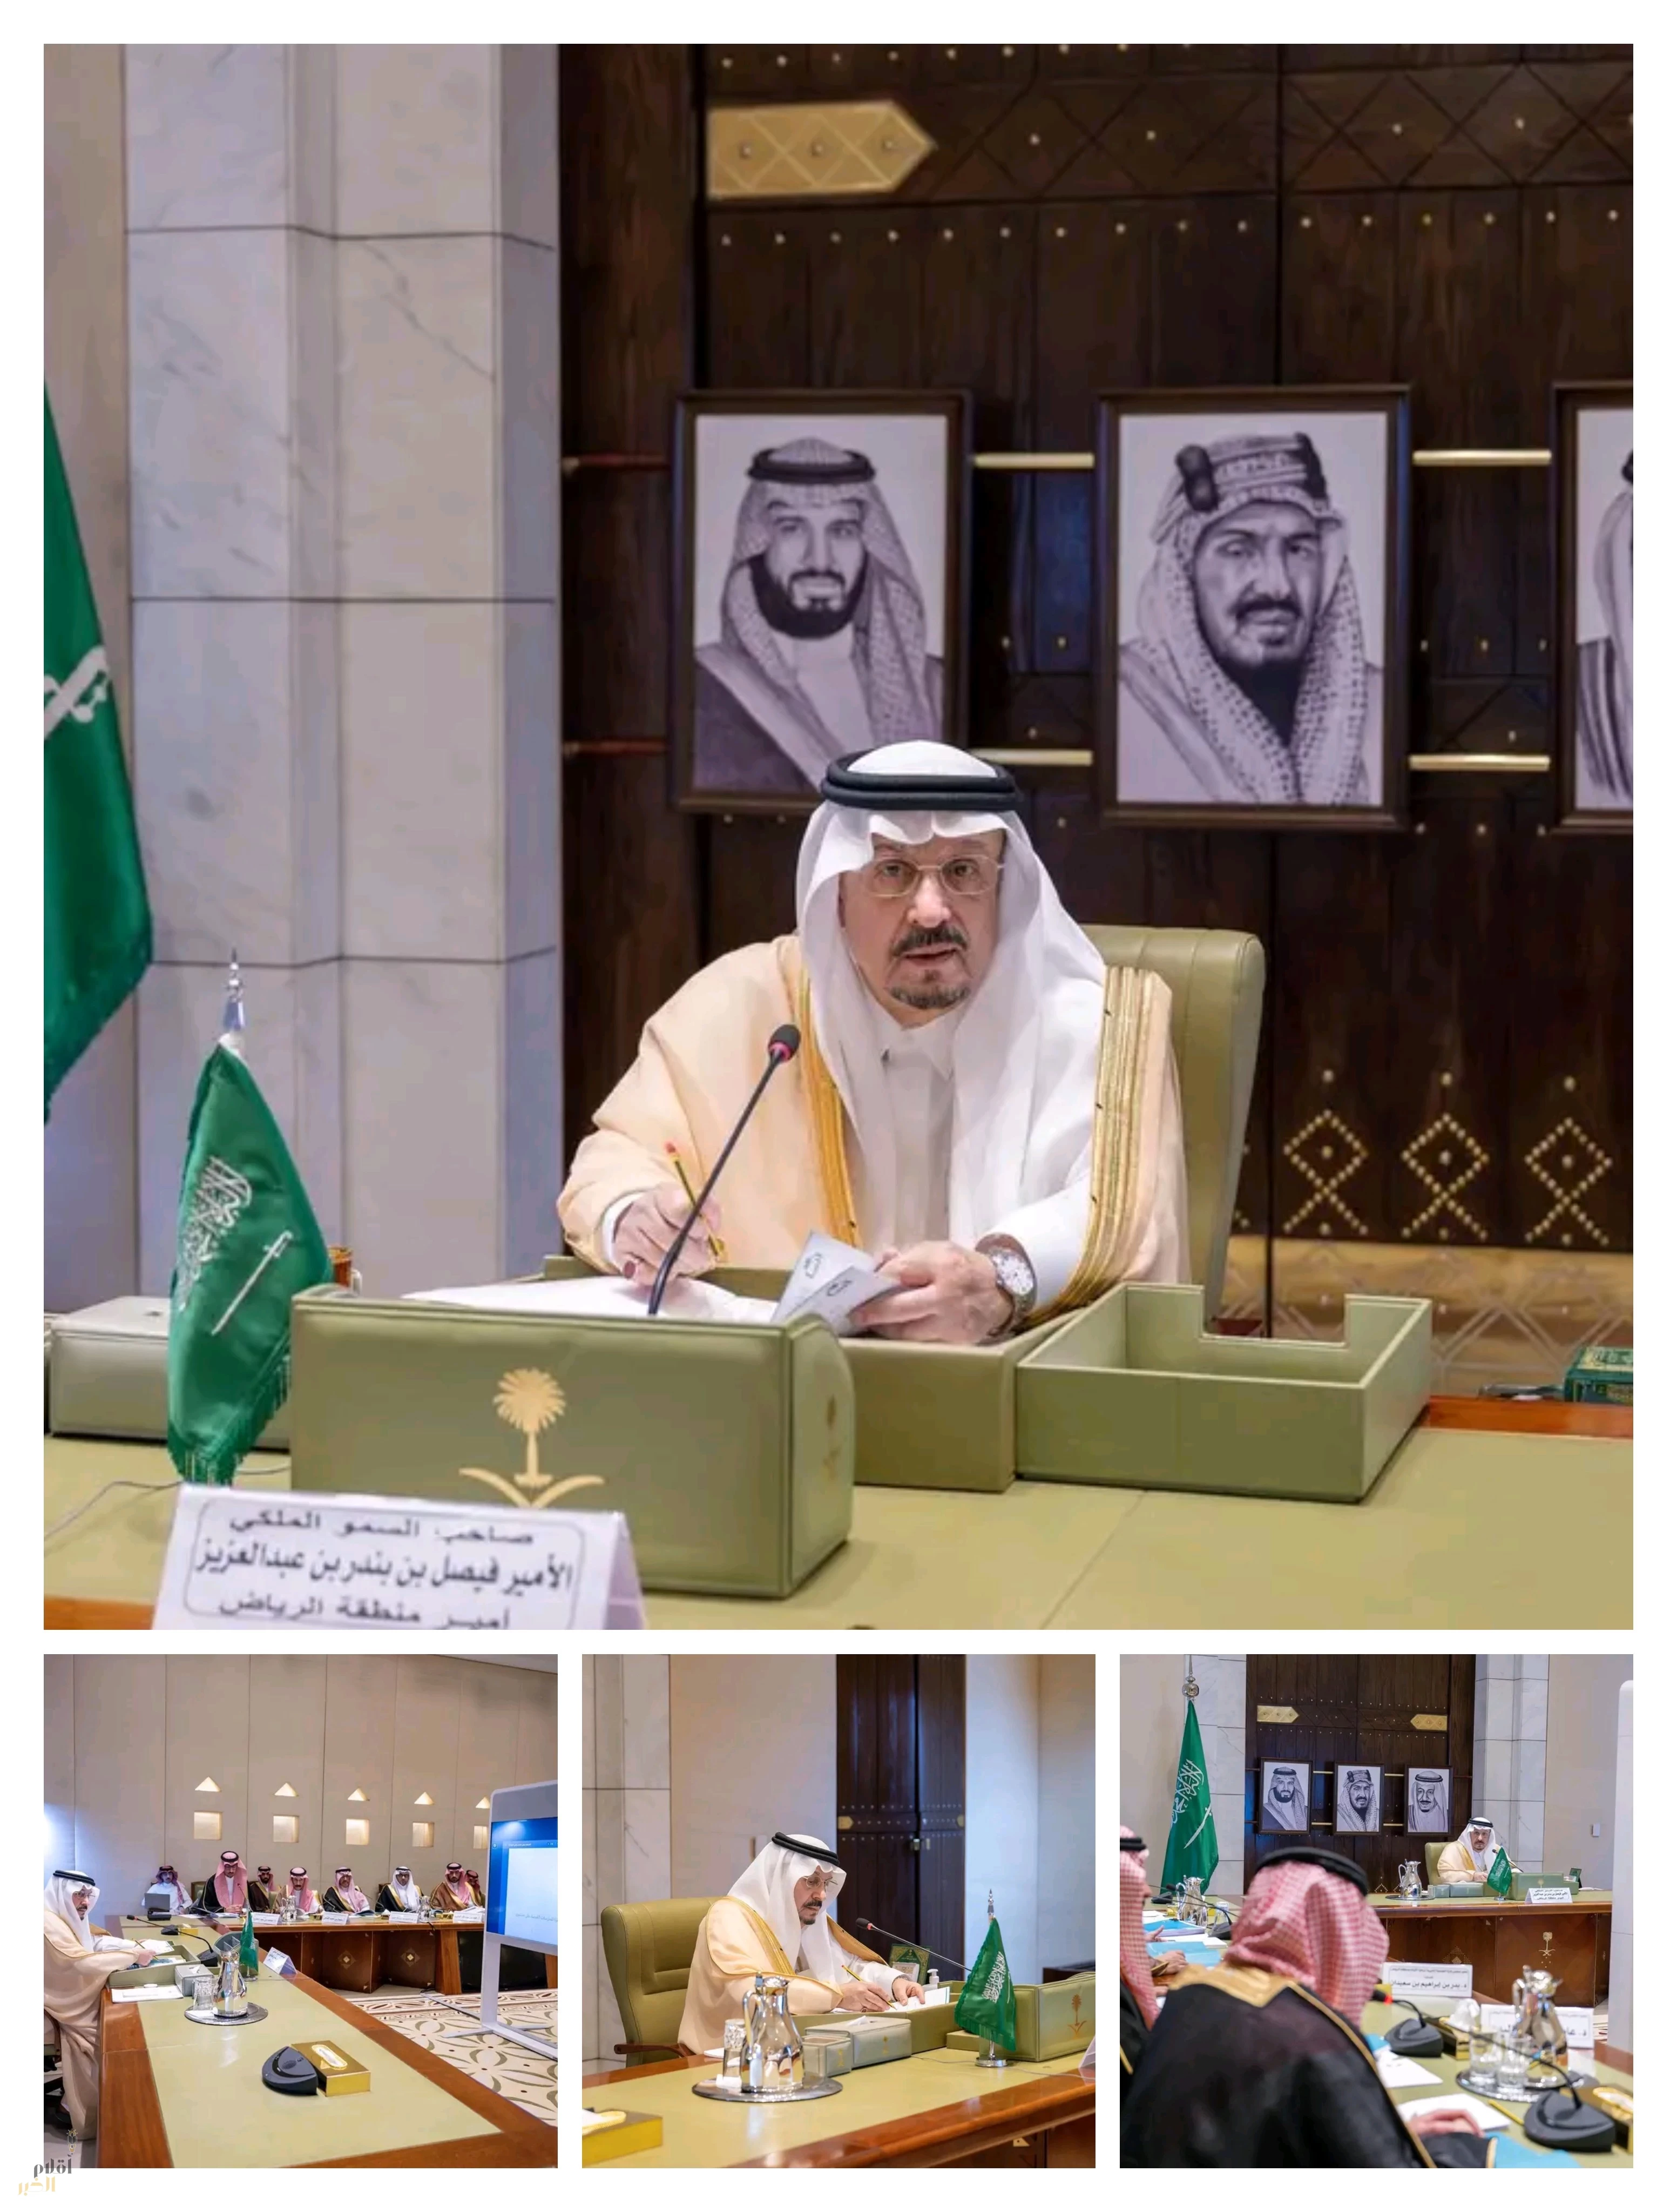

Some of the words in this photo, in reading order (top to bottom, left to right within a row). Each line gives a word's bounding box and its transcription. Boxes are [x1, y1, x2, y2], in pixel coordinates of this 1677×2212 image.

[334, 1518, 420, 1537] السمو
[435, 1525, 533, 1545] صاحب
[196, 1537, 305, 1579] عبدالعزيز
[310, 1549, 340, 1582] بن
[340, 1551, 393, 1586] بندر
[397, 1555, 427, 1588] بن
[431, 1554, 499, 1594] فيصل
[501, 1552, 573, 1596] الأمير
[219, 1590, 324, 1620] الرياض
[336, 1596, 421, 1622] منطقة
